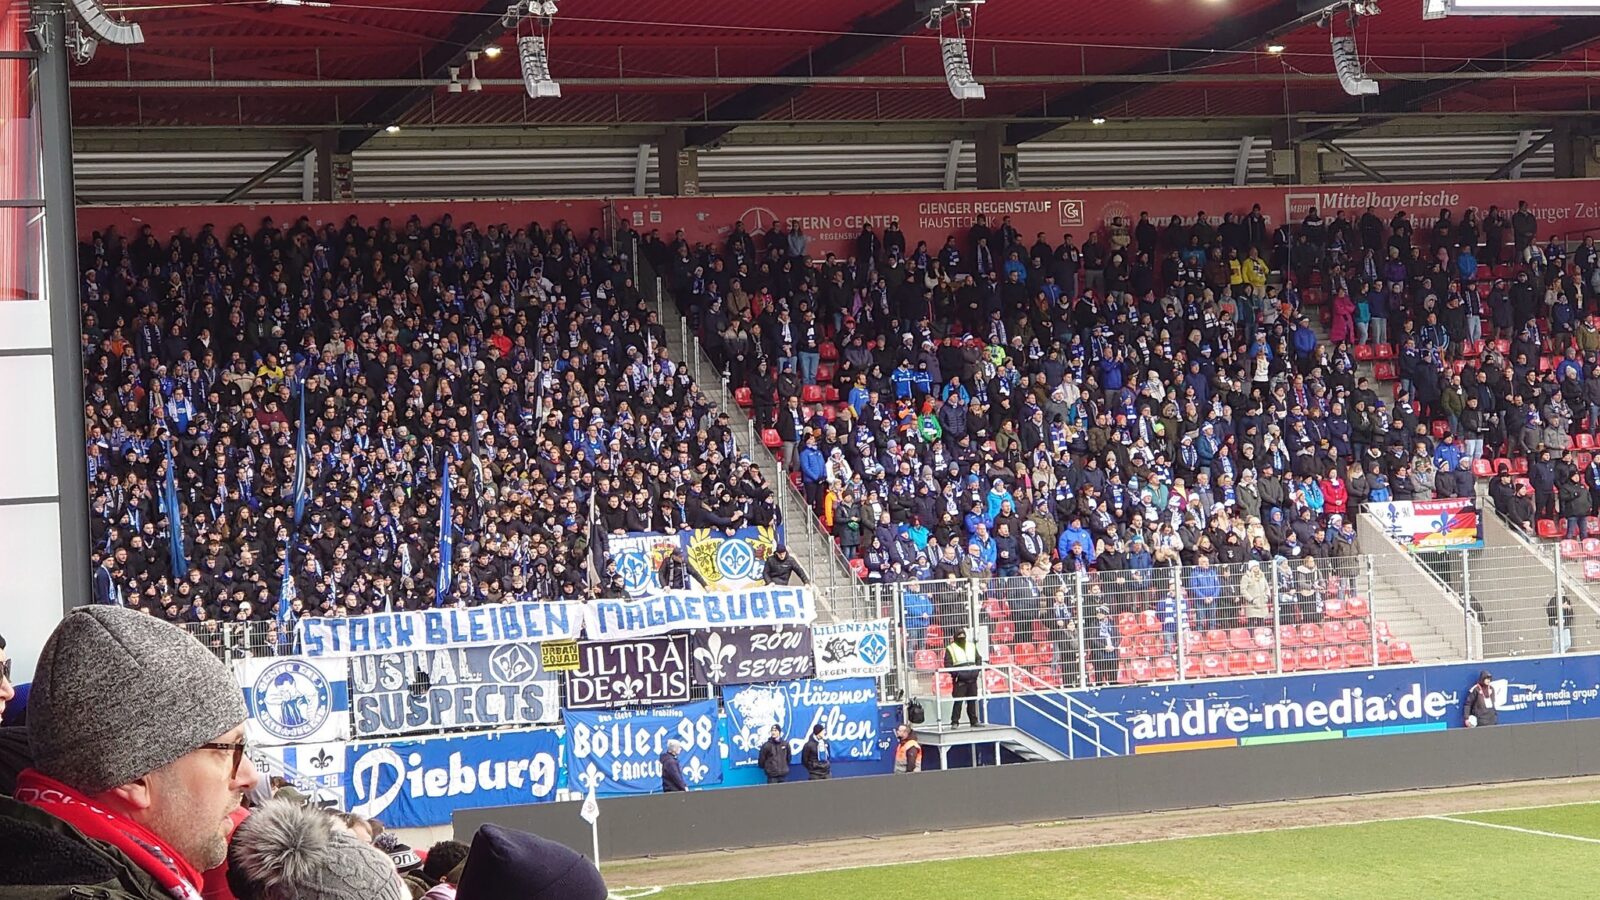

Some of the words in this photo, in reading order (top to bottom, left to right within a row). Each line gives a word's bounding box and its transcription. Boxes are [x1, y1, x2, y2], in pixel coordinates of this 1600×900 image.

[919, 202, 971, 214] GIENGER
[974, 201, 1051, 213] REGENSTAUF
[1322, 191, 1459, 210] Mittelbayerische
[920, 216, 997, 228] HAUSTECHIK
[820, 232, 861, 241] REGENSBU
[303, 613, 414, 656] STARK
[424, 603, 569, 644] BLEIBEN
[597, 589, 805, 634] MAGDEBURG!
[813, 622, 888, 636] LILIENFANS
[542, 645, 577, 655] URBAN
[750, 631, 803, 652] ROW
[543, 653, 578, 664] SQUAD
[573, 635, 684, 677] ULTRÀ
[736, 655, 811, 678] SEVEN
[352, 648, 483, 693] USUAL
[571, 677, 612, 703] DE
[644, 672, 686, 697] LIS
[1512, 690, 1543, 702] andré
[1546, 689, 1570, 700] media
[1572, 688, 1598, 701] group
[358, 684, 545, 732] SUSPECTS
[1133, 683, 1447, 740] andre-media.de
[573, 721, 669, 759] Böller
[678, 714, 712, 752] 98
[850, 741, 873, 757] e.V.
[612, 760, 663, 782] FANCLU
[350, 748, 556, 821] Dieburg
